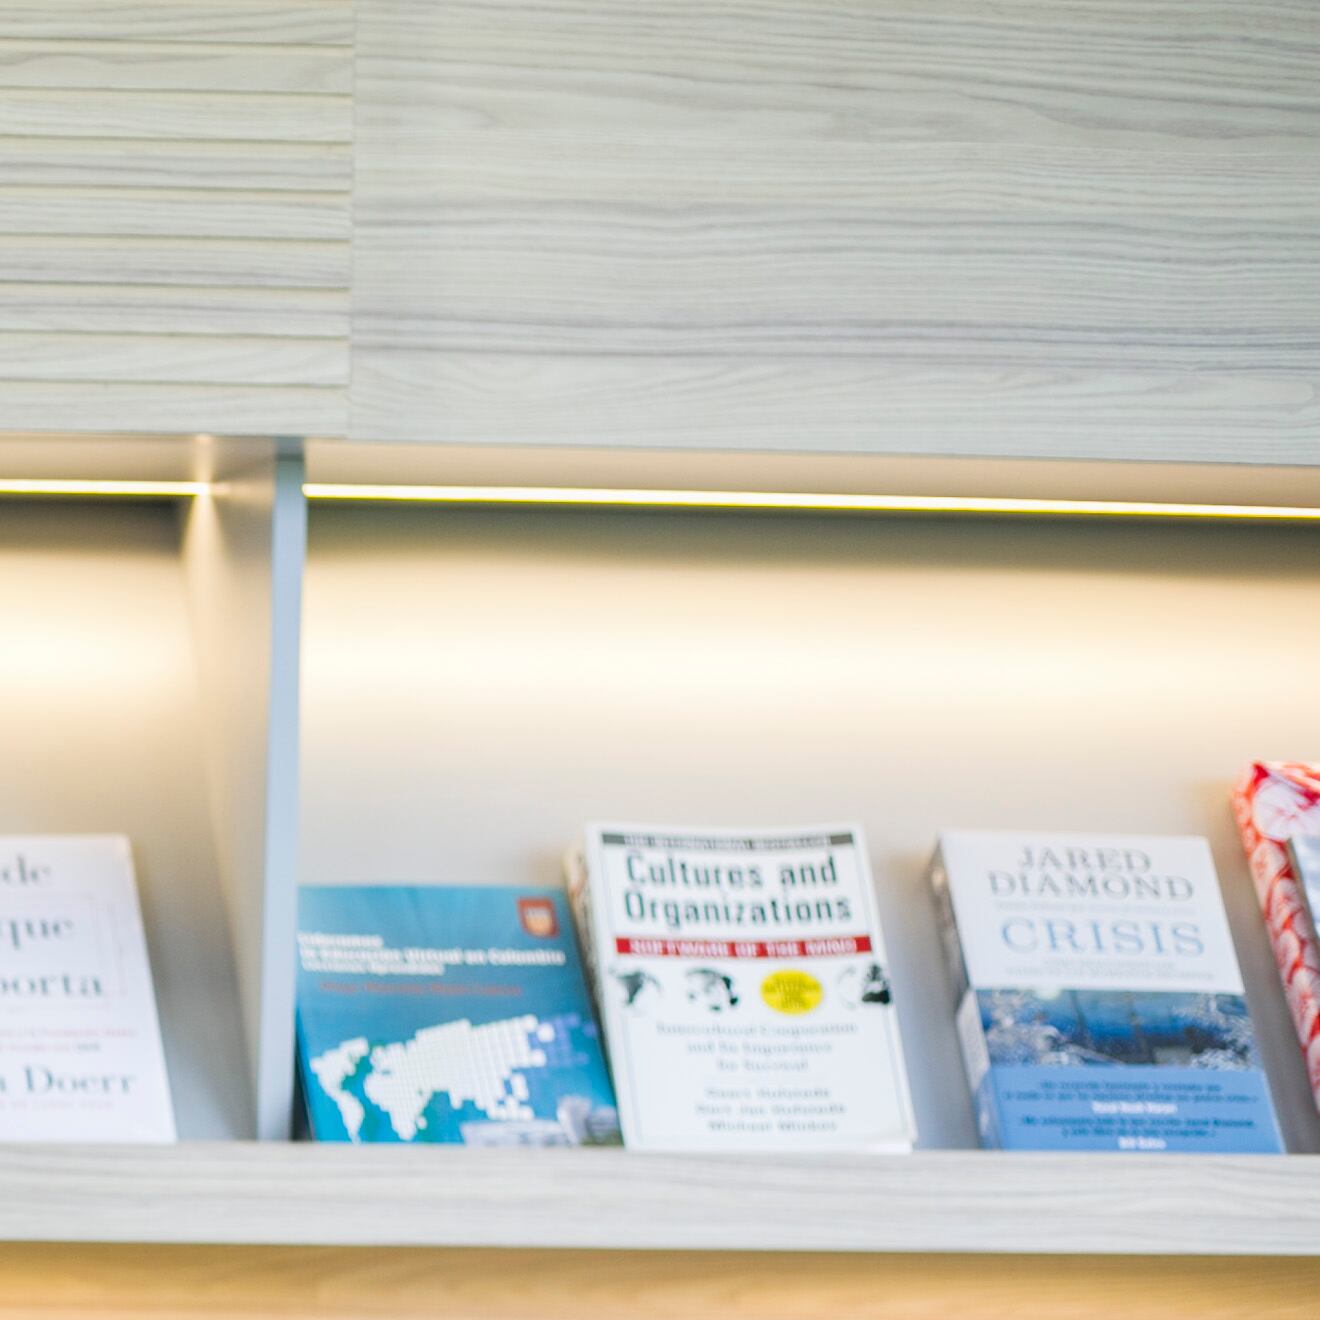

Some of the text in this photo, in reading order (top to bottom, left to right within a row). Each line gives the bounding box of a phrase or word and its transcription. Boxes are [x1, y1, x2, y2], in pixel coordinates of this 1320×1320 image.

[626, 854, 838, 888] Cultures and
[1018, 846, 1152, 873] JARED
[988, 871, 1196, 900] DIAMOND
[624, 890, 852, 928] Organizations
[1001, 916, 1205, 958] CRISIS
[23, 1065, 135, 1095] Doerr
